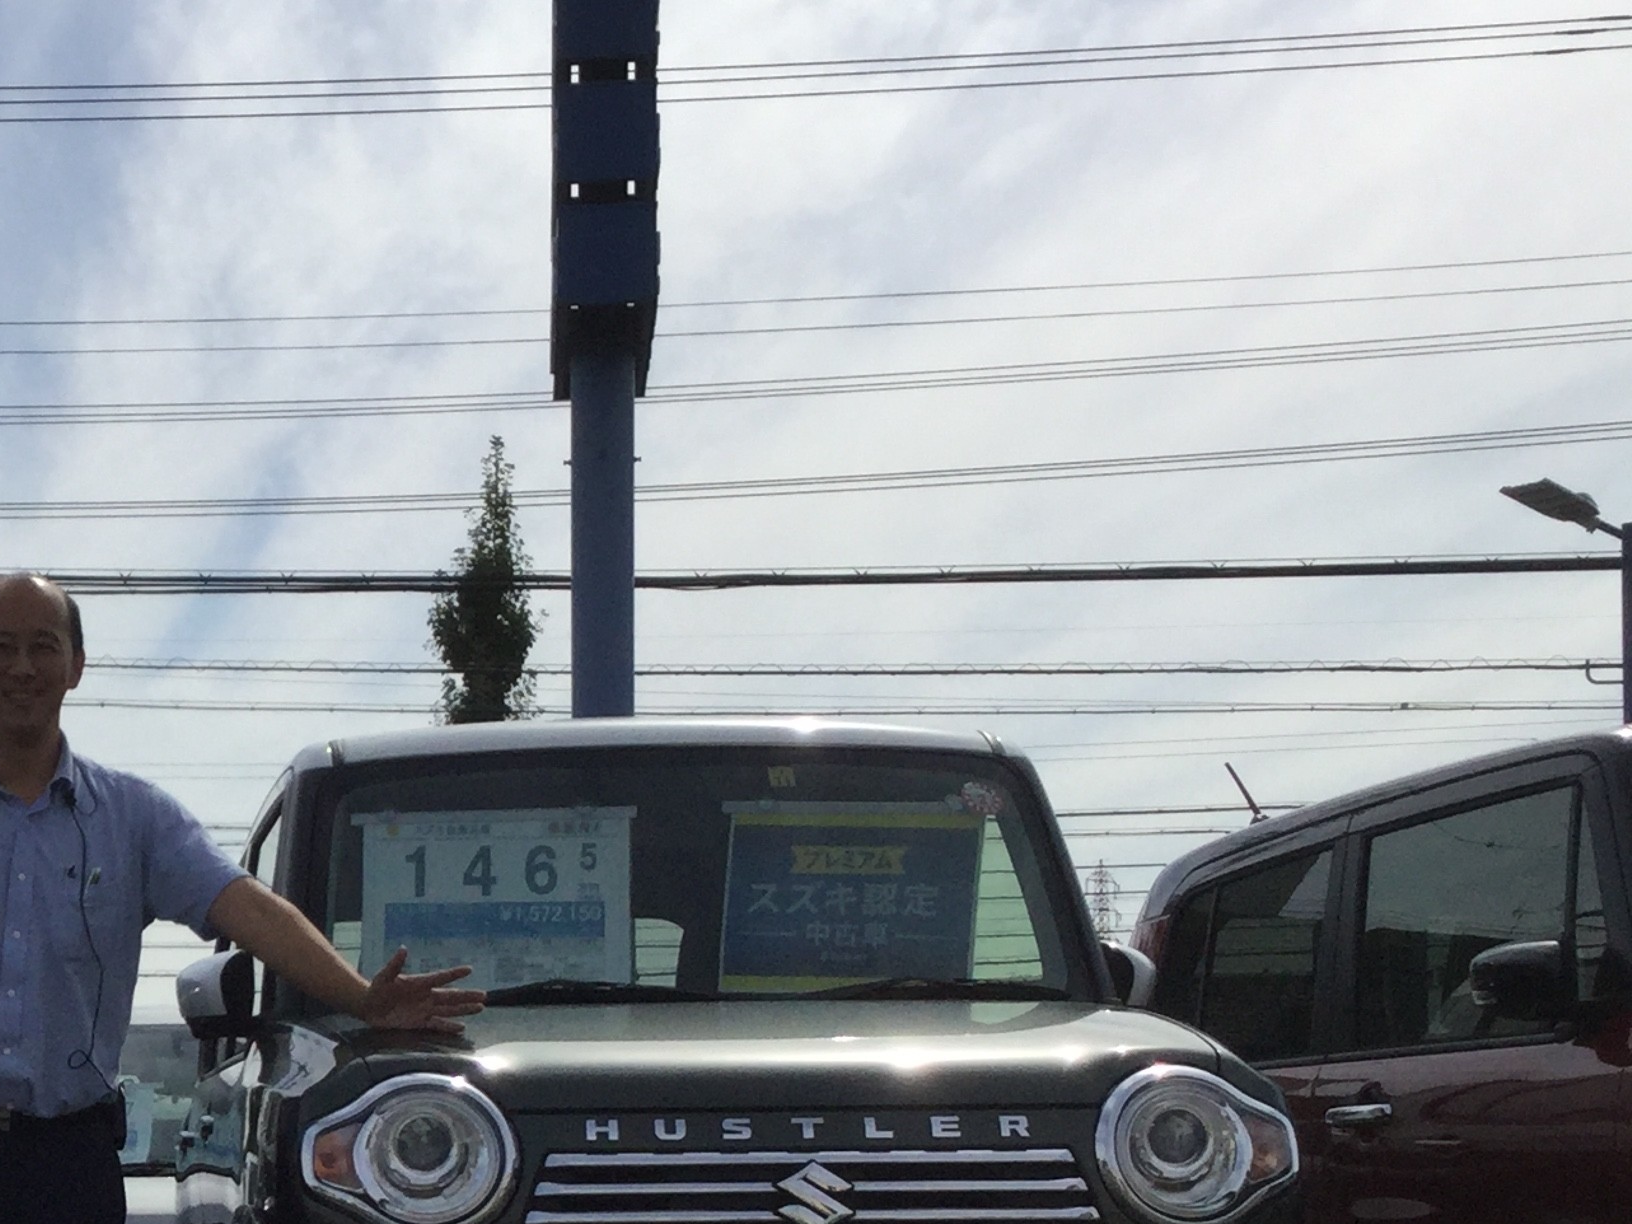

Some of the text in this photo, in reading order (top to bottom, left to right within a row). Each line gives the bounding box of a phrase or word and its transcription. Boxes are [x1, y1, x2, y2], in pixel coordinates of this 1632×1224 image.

[747, 881, 940, 917] スズキ認定
[584, 1114, 1032, 1141] HUSTLER
